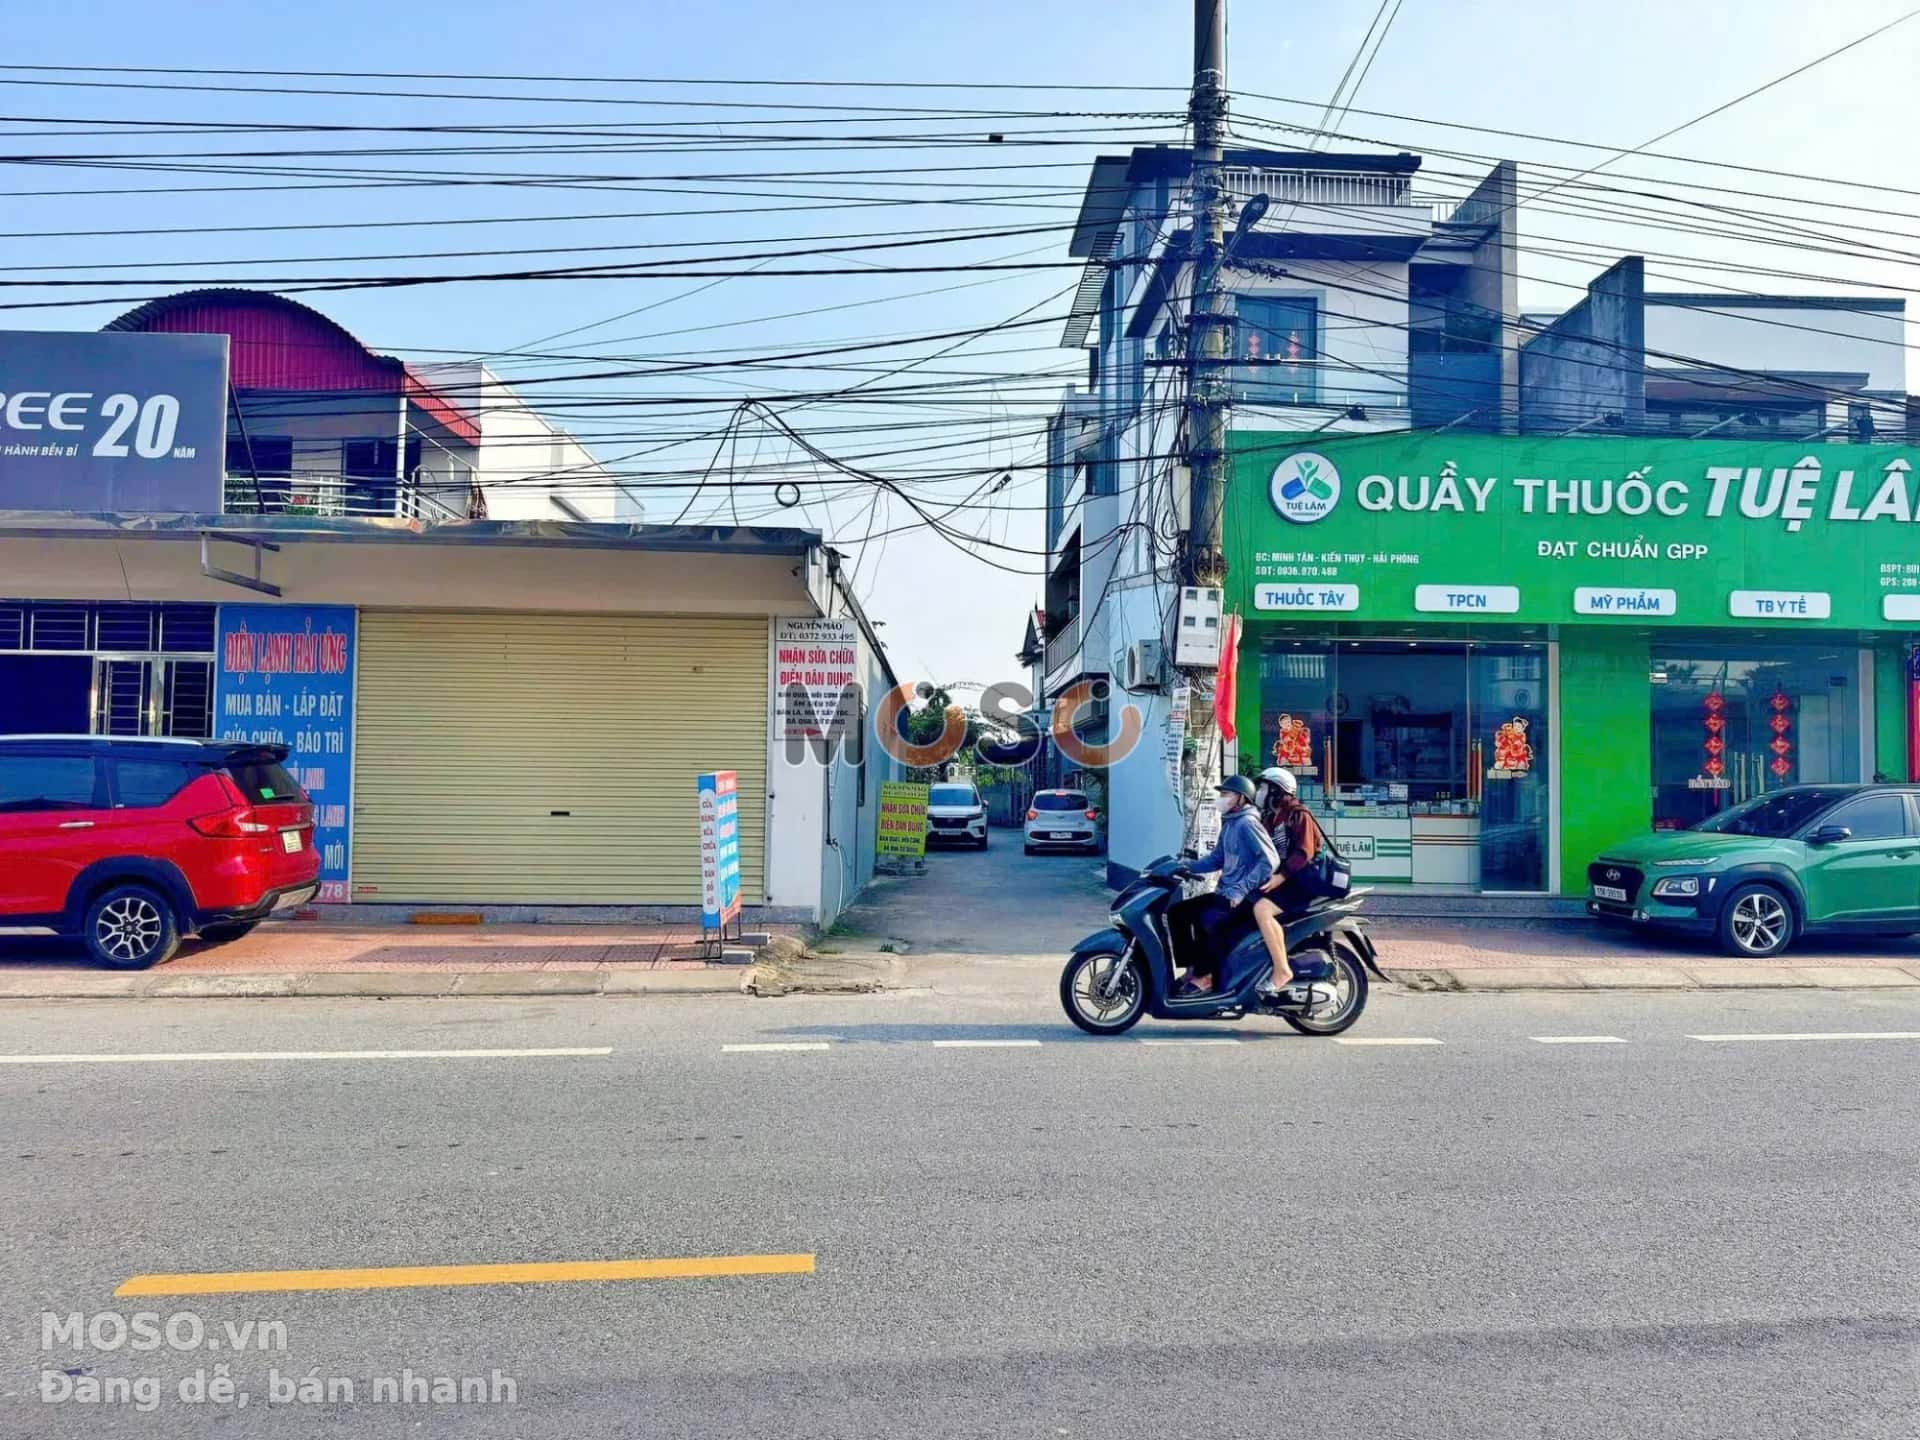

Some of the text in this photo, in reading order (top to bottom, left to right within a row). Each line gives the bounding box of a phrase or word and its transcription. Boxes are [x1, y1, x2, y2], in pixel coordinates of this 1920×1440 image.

[0, 391, 93, 430] EE
[92, 393, 180, 458] 20
[1356, 455, 1920, 532] QUẦY THUỐC TUỆ LÂ
[1537, 535, 1709, 560] ĐẠT CHUẨN GPP
[1265, 587, 1345, 606] THUỐC TÂY
[1447, 593, 1487, 608] TPCN
[1590, 592, 1660, 610] MỸ PHẨM
[1755, 595, 1807, 614] TB Y TẾ
[778, 645, 855, 667] NHẬN SỬA CHỮA
[780, 668, 854, 689] ĐIỆN DÂN DỤNG
[225, 693, 252, 716] MUA
[255, 689, 281, 717] BÁN
[319, 690, 344, 722] ĐẶT
[296, 723, 321, 753] BẢO
[324, 839, 345, 870] MỚI
